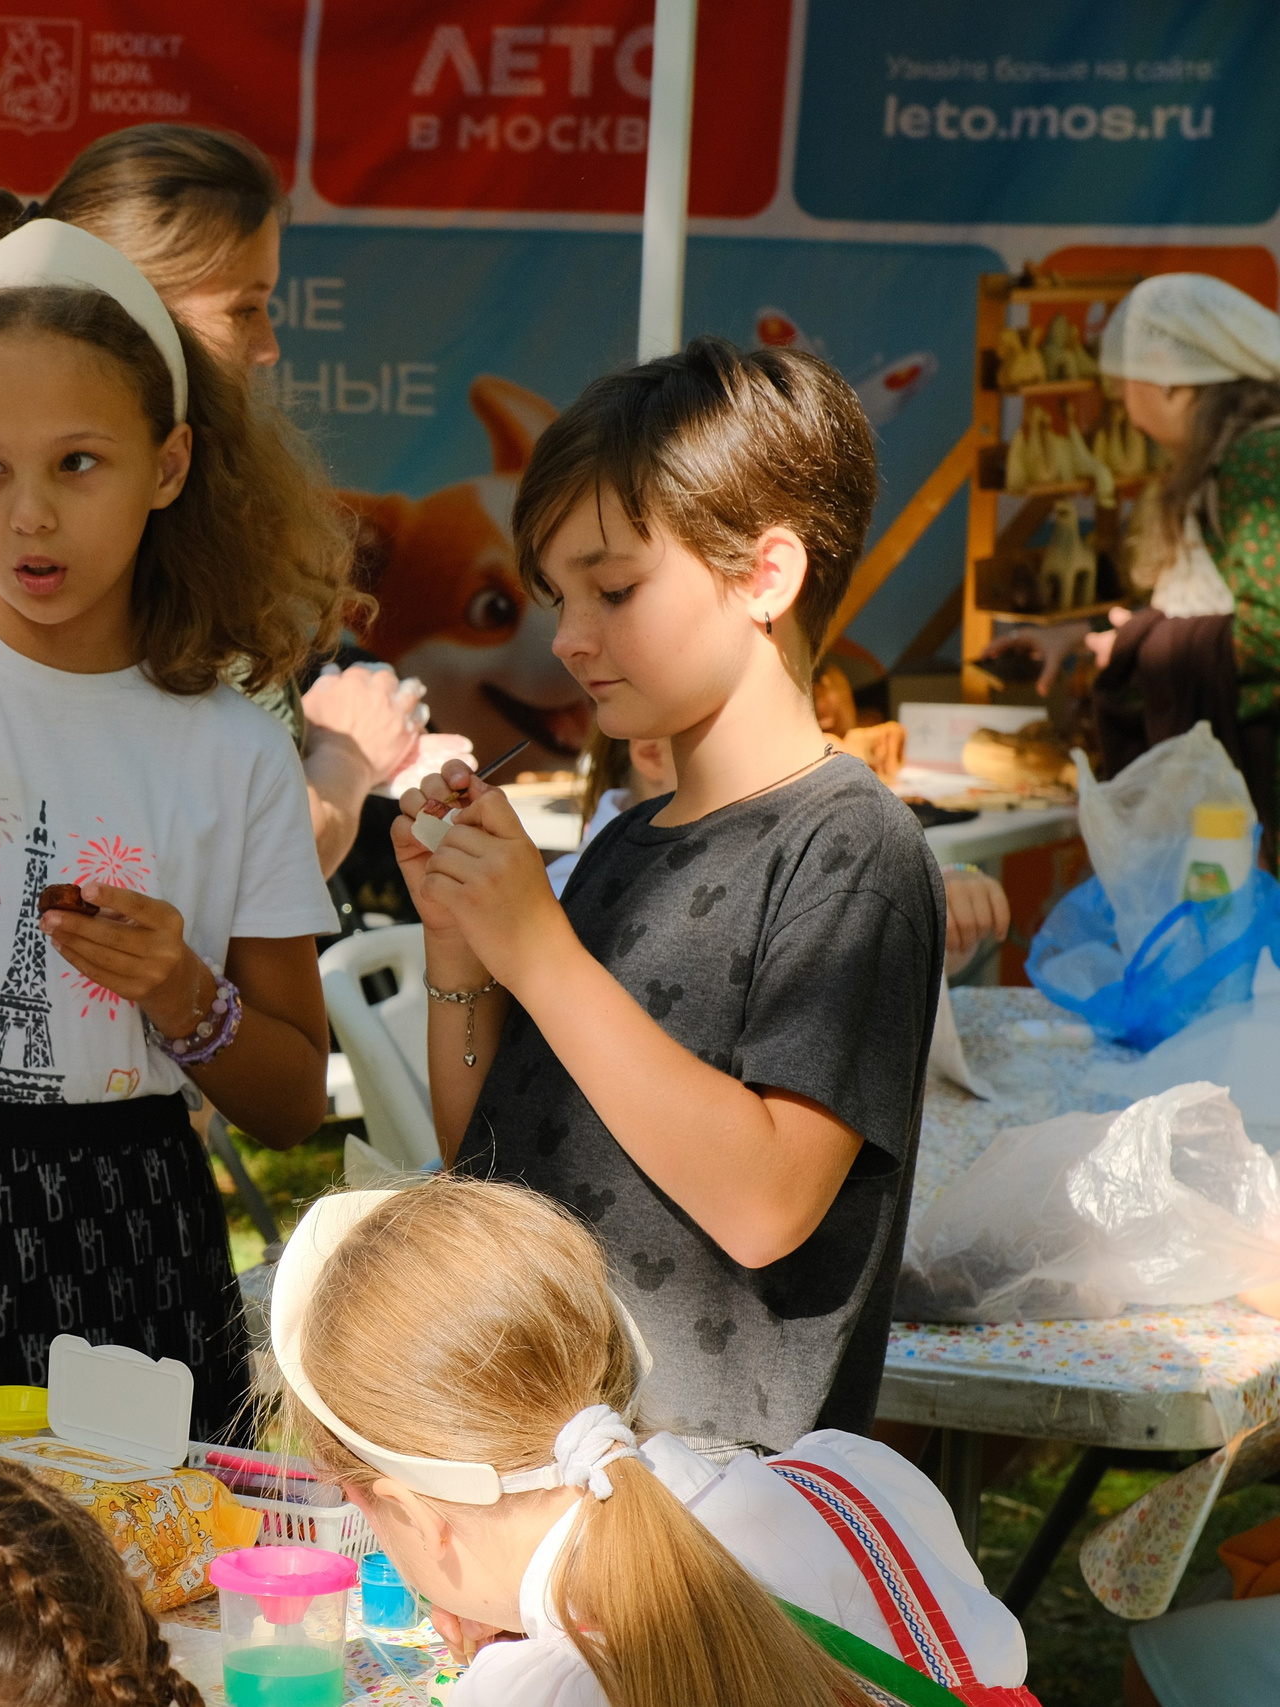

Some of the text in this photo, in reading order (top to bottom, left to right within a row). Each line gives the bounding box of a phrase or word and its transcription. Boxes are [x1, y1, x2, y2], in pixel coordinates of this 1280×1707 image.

[408, 113, 649, 153] В МОСКВ
[884, 94, 1214, 141] leto.mos.ru
[268, 276, 345, 331] ЫЕ
[271, 361, 438, 416] НЫЕ
